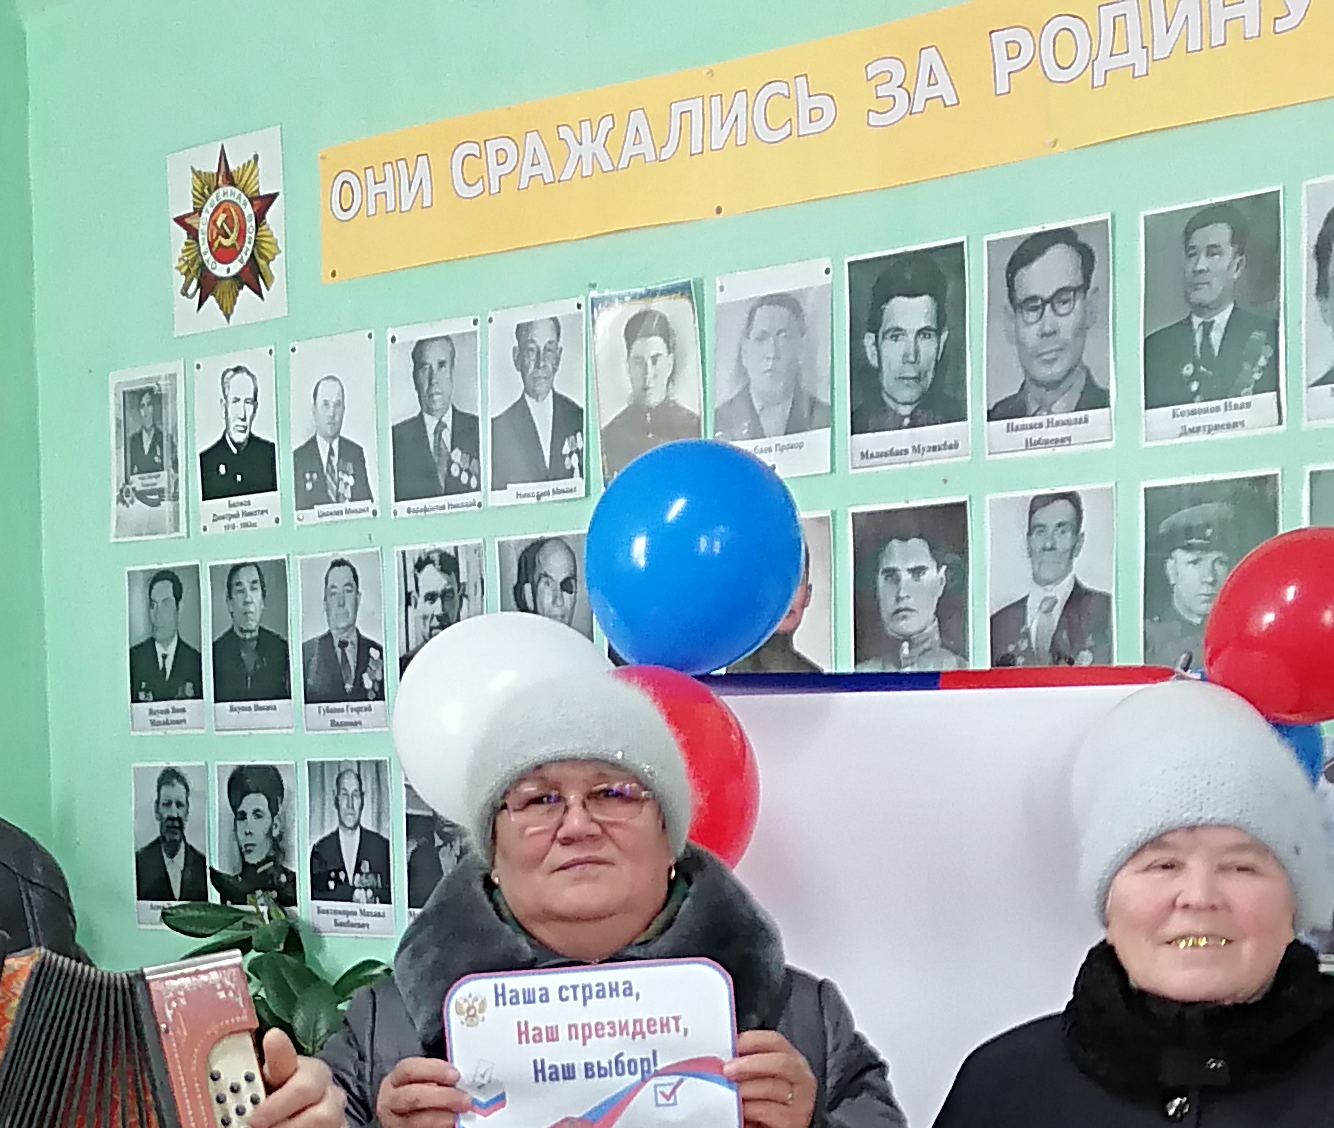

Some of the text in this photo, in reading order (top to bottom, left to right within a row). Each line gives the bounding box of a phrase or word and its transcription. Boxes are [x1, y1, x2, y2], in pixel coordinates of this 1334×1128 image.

[329, 154, 433, 222] ОНИ
[450, 74, 838, 200] СРАЖАЛИСЬ
[865, 45, 959, 127] ЗА
[494, 980, 640, 1006] Наша страна,
[517, 1015, 689, 1045] Наш президент,
[533, 1050, 658, 1083] Наш выбор!
